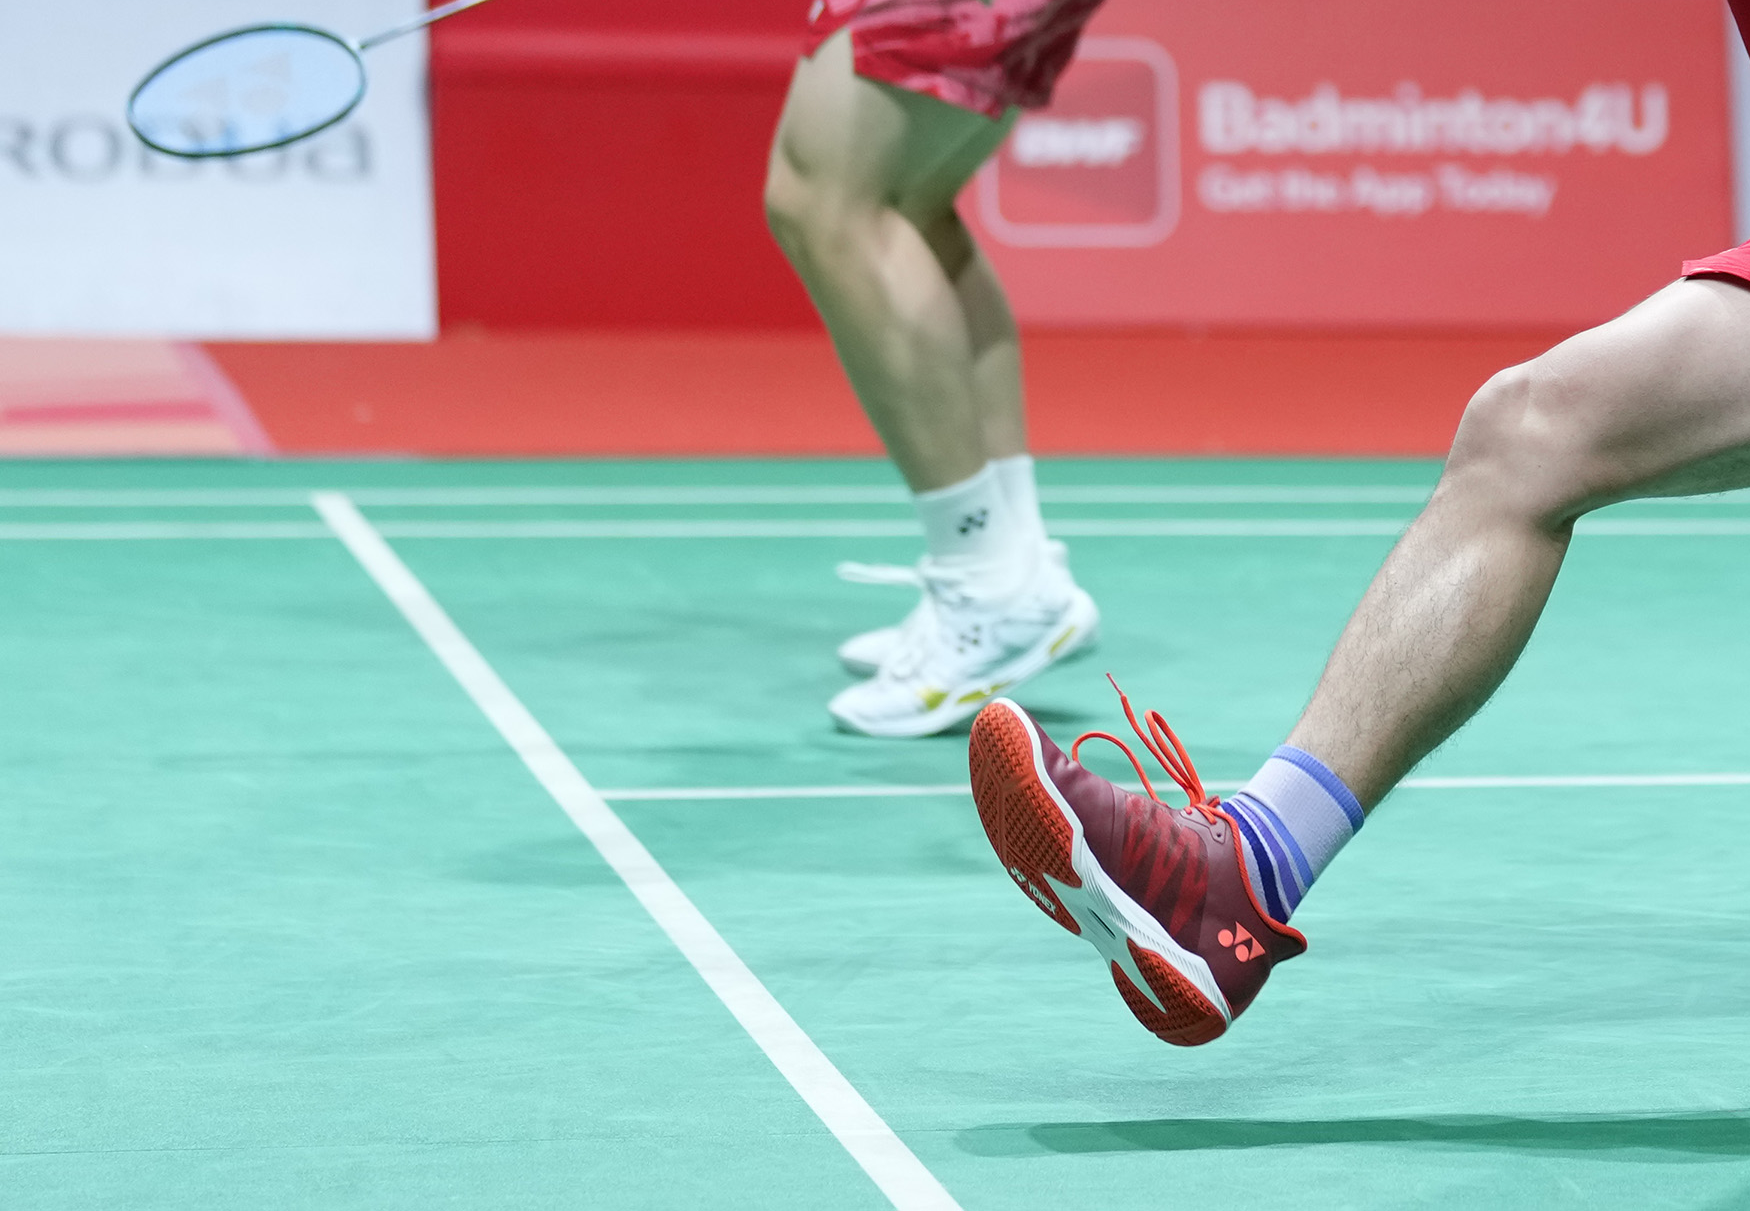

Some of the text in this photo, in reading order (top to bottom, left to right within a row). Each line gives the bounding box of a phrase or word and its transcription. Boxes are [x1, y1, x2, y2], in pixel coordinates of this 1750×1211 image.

[1201, 81, 1669, 154] Badminton4U
[1436, 163, 1556, 217] Today
[1028, 880, 1056, 915] YONEX
